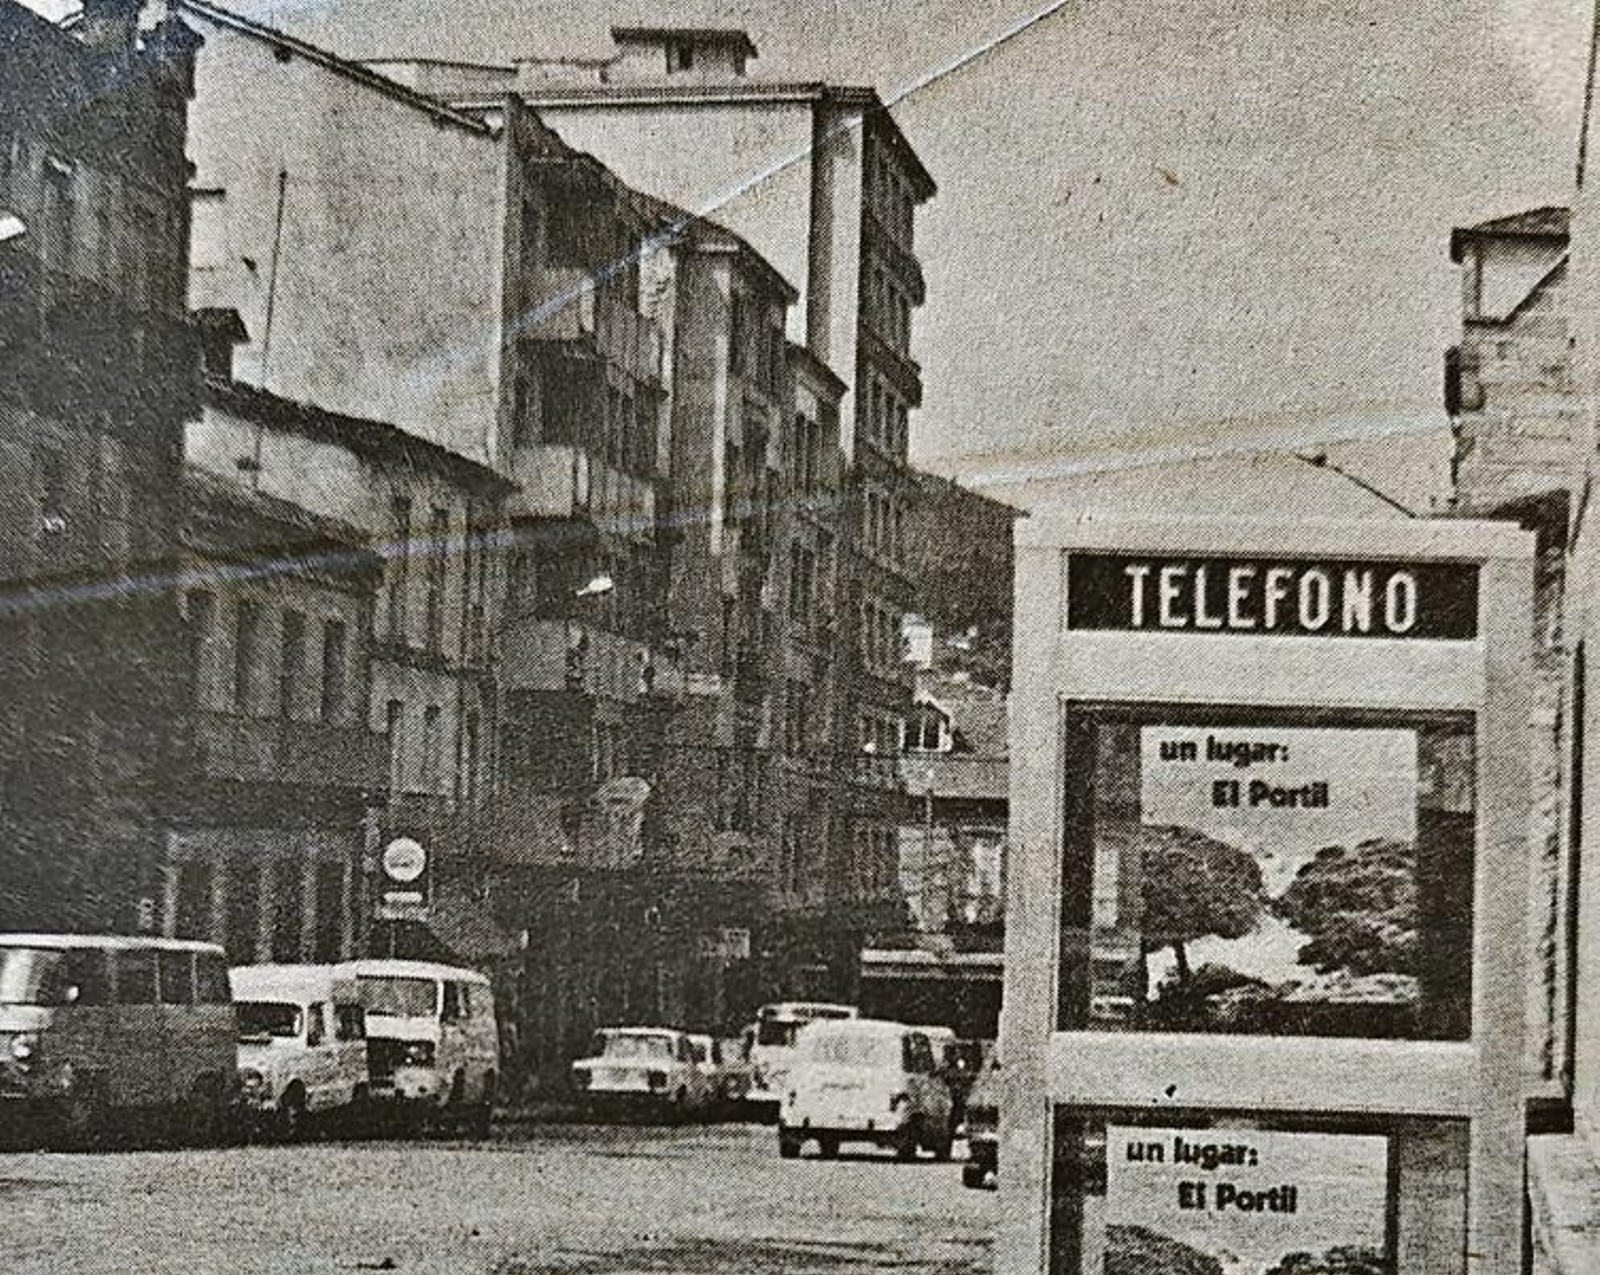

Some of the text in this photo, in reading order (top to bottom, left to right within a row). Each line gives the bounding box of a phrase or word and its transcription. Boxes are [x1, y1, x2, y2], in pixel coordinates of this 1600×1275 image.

[1125, 565, 1418, 633] TELEFONO
[1160, 734, 1289, 769] un lugar:
[1211, 780, 1329, 809] El Portil
[1126, 1137, 1259, 1171] un lugar:
[1177, 1181, 1298, 1214] El Portil
